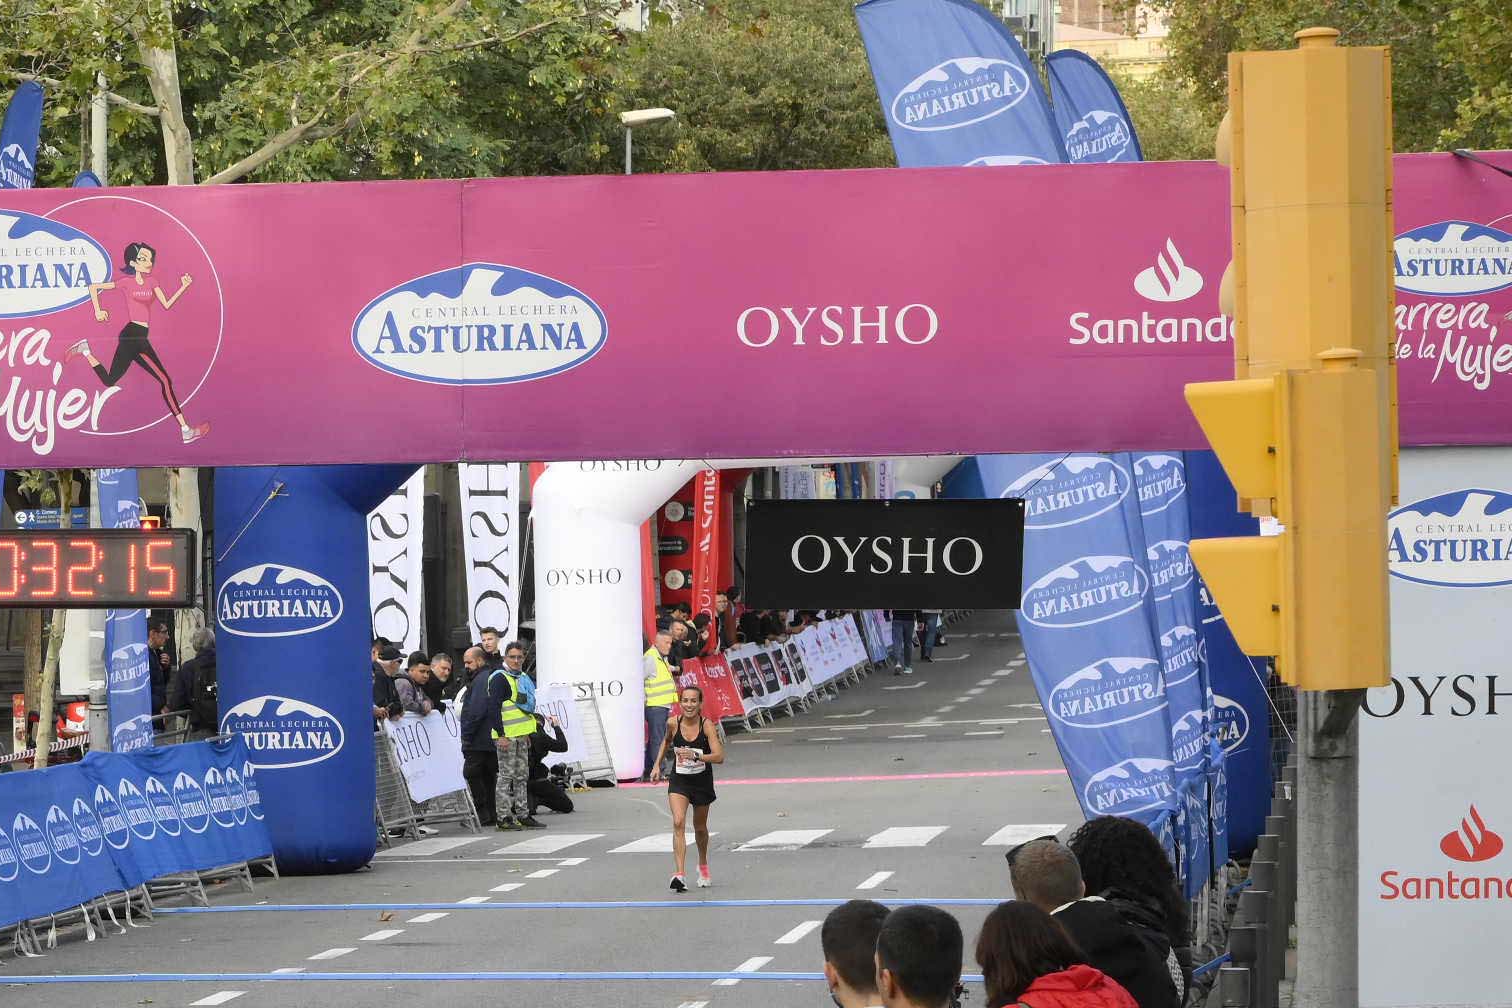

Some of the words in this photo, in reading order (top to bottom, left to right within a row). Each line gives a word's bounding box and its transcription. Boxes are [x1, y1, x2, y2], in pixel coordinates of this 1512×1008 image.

[14, 245, 87, 257] LECHERA
[1465, 246, 1512, 254] LECHER
[411, 305, 490, 319] CENTRAL
[497, 303, 579, 318] LECHERA
[735, 302, 939, 348] OYSHO
[1394, 302, 1490, 331] arrera
[371, 310, 587, 355] ASTURIANA
[1068, 312, 1236, 345] Santand
[1417, 330, 1436, 359] la
[1431, 325, 1512, 391] Muje
[1415, 523, 1481, 533] CENTRAL
[790, 534, 984, 576] OYSHO
[1388, 526, 1512, 564] ASTURI
[546, 567, 622, 586] OYSHO
[220, 592, 334, 621] ASTURIANA
[233, 588, 277, 597] CENTRAL
[280, 588, 329, 597] LECHERA
[1360, 674, 1512, 718] OYSH
[225, 724, 334, 750] TURIANA
[235, 720, 279, 729] CENTRAL
[282, 720, 330, 729] LECHERA
[1380, 870, 1512, 900] Santan
